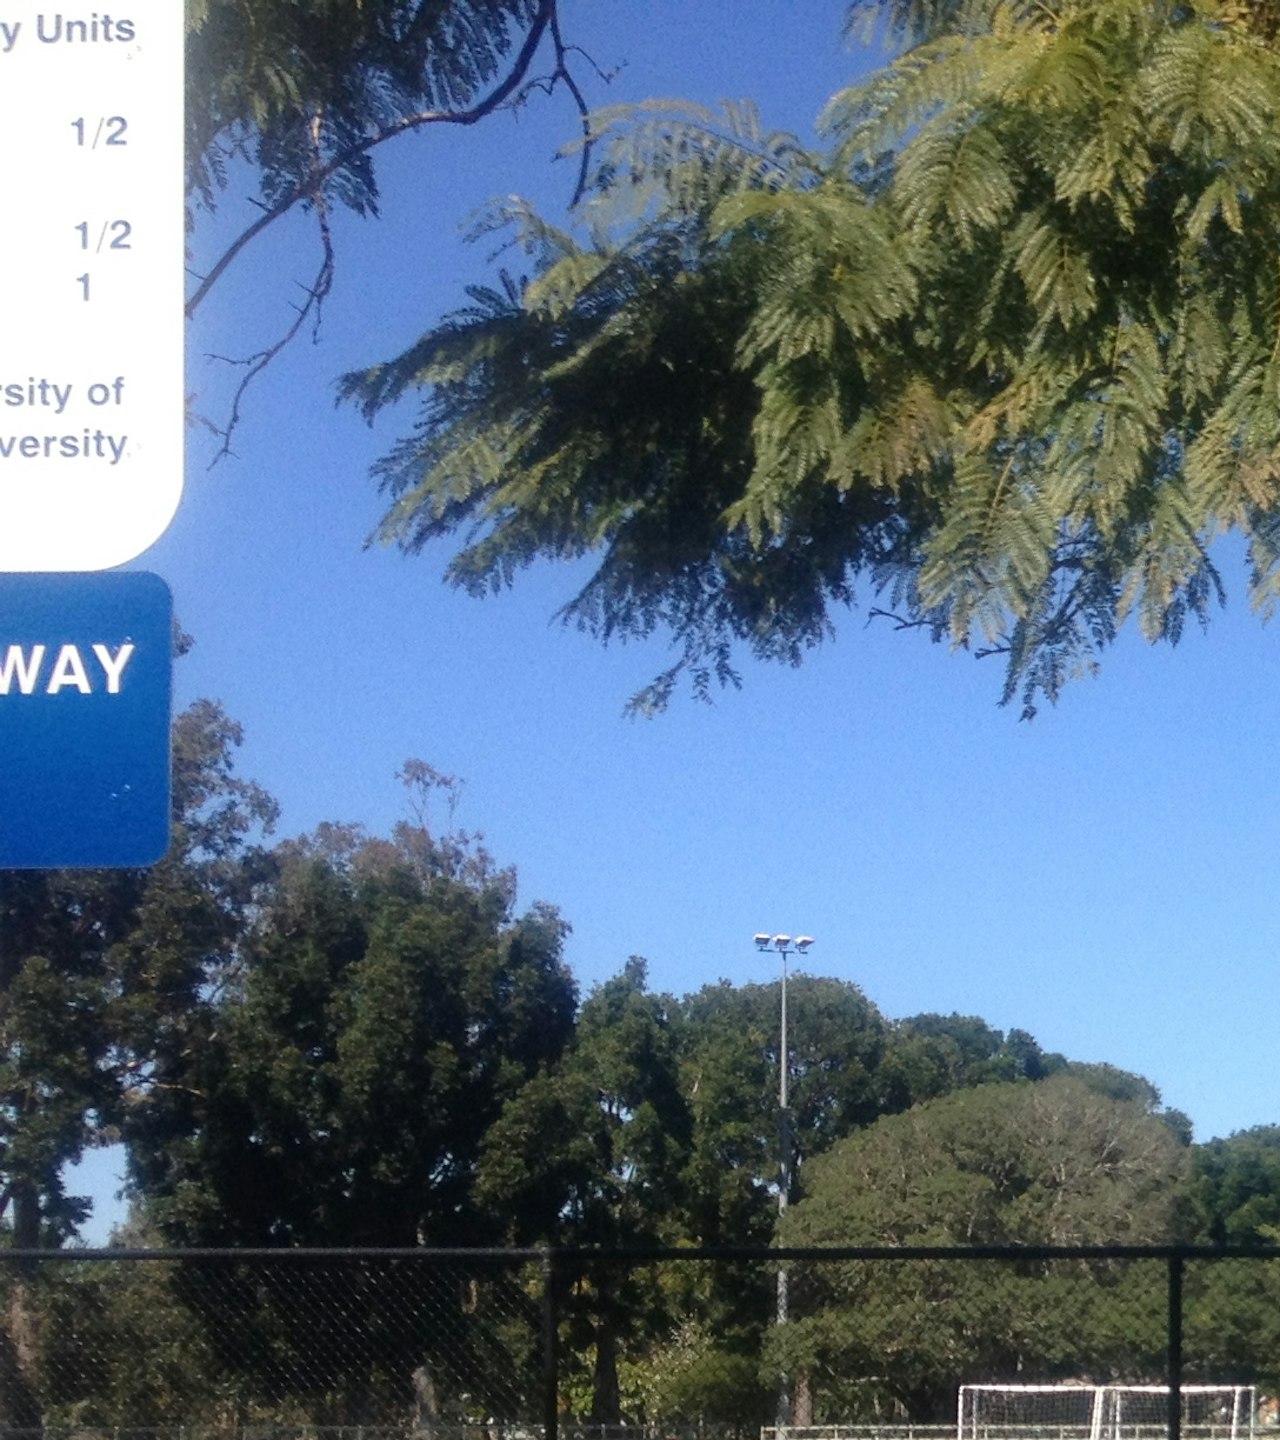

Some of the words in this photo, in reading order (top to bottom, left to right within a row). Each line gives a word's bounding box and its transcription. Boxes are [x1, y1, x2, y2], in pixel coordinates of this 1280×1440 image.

[37, 12, 136, 44] Units
[70, 116, 128, 150] 1/2
[74, 220, 132, 254] 1/2
[76, 272, 91, 302] 1
[0, 376, 73, 414] sity
[87, 376, 125, 406] of
[0, 428, 128, 466] versity
[0, 643, 136, 695] WAY
